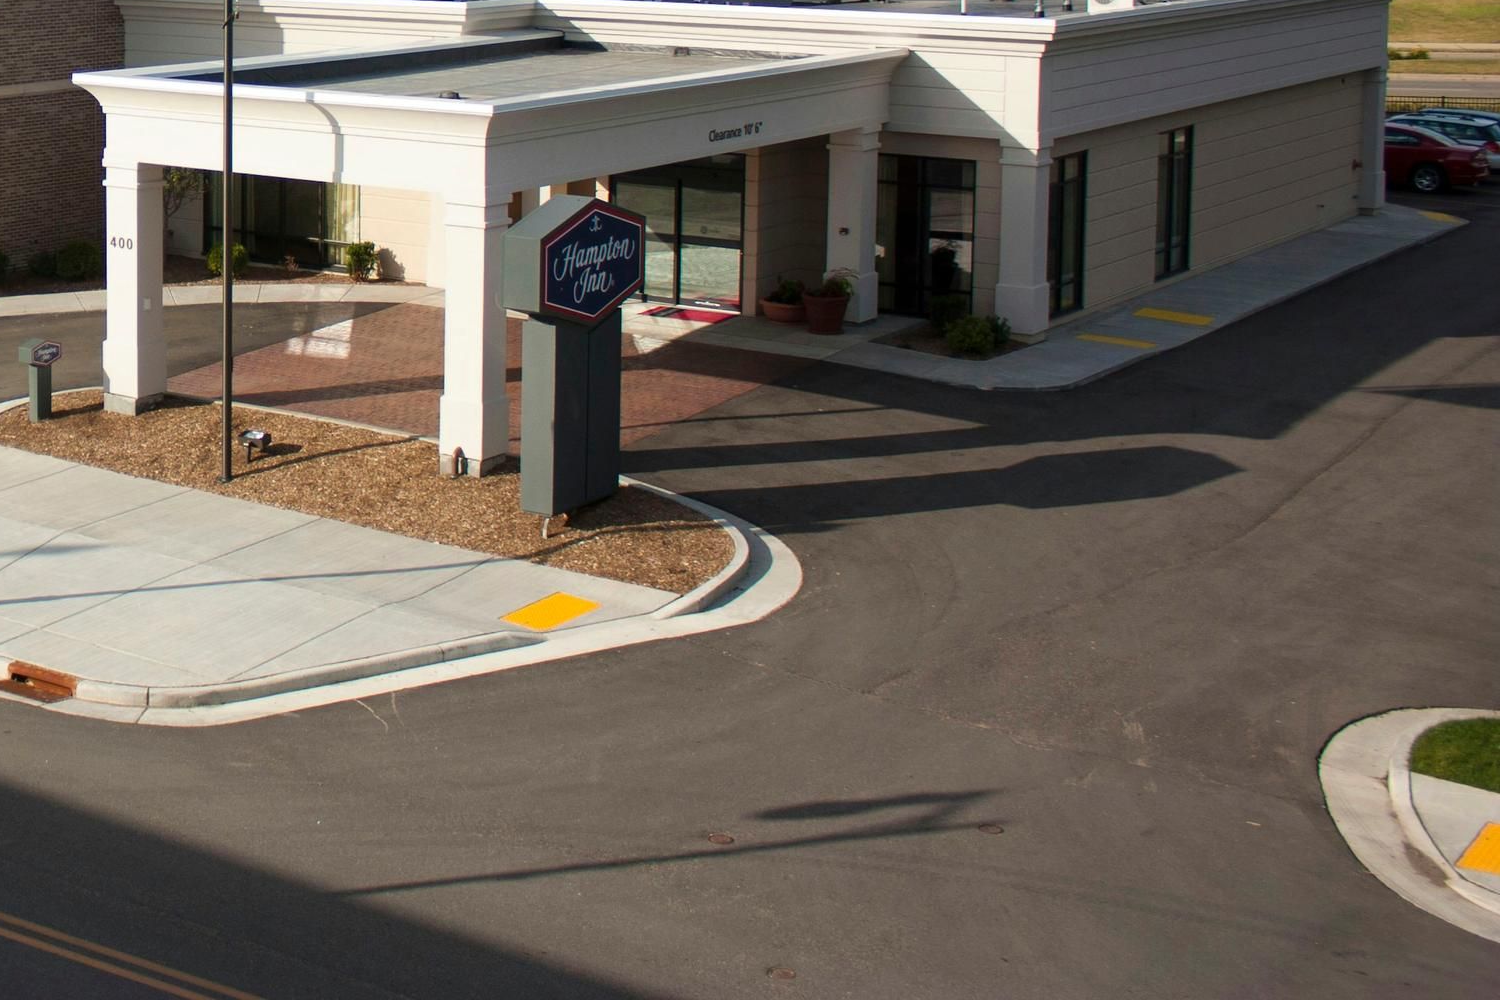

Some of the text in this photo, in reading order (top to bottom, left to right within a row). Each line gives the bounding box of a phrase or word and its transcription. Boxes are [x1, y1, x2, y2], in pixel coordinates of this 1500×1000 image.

[708, 128, 742, 142] Clearance
[110, 236, 133, 250] 400
[553, 236, 635, 281] Hampton
[573, 267, 613, 304] Inn
